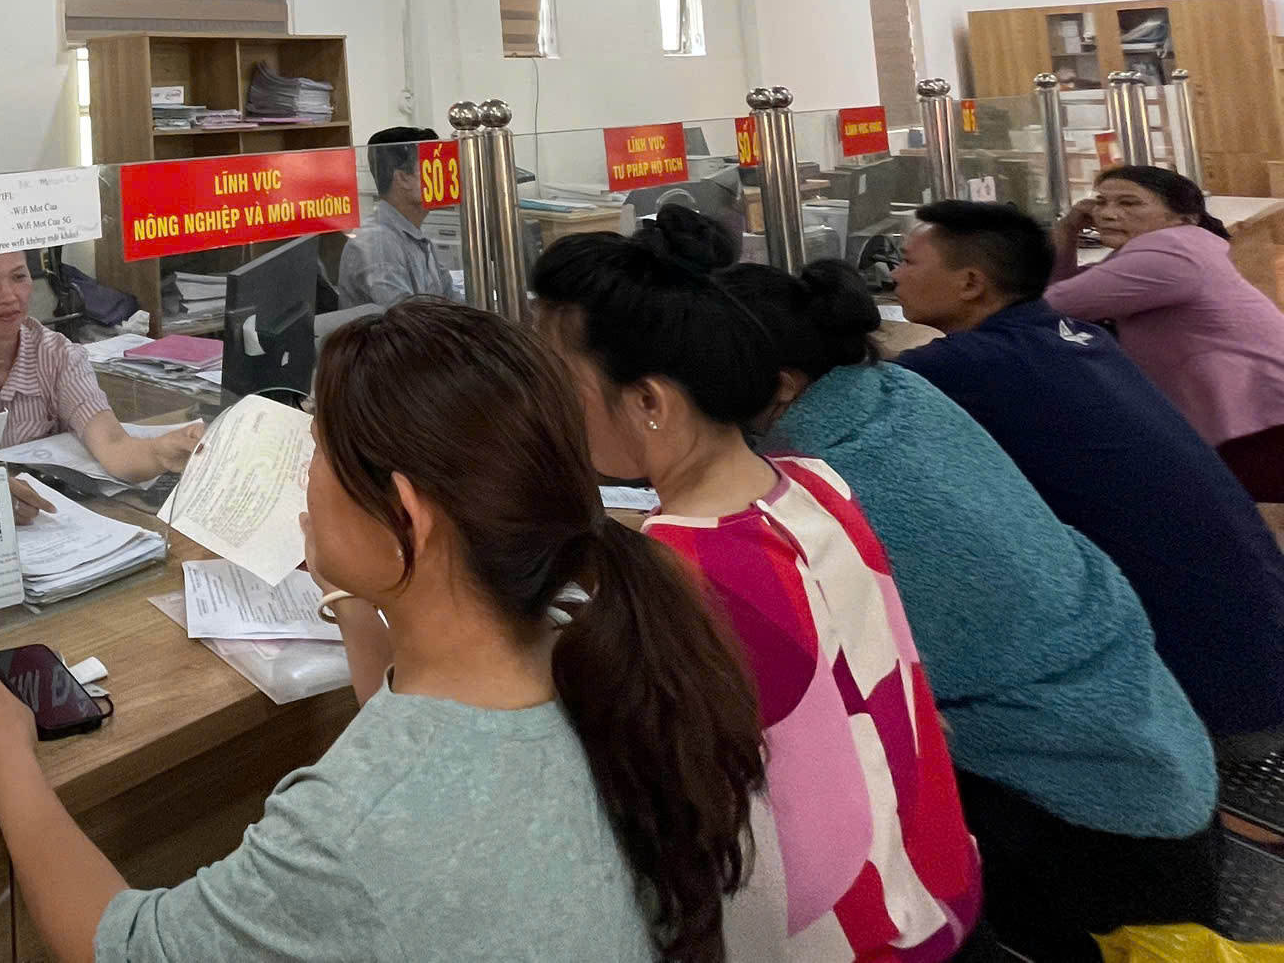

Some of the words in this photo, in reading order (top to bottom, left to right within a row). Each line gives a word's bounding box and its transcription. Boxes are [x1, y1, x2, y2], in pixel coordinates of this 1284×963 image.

[737, 120, 751, 164] SỐ
[214, 171, 248, 196] LĨNH
[252, 168, 282, 194] VỰC
[422, 143, 445, 203] SỐ
[449, 158, 460, 200] 3
[133, 213, 179, 241] NÔNG
[184, 204, 240, 234] NGHIỆP
[244, 201, 264, 227] VÀ
[268, 198, 295, 223] MÔI
[299, 193, 351, 218] TRƯỜNG
